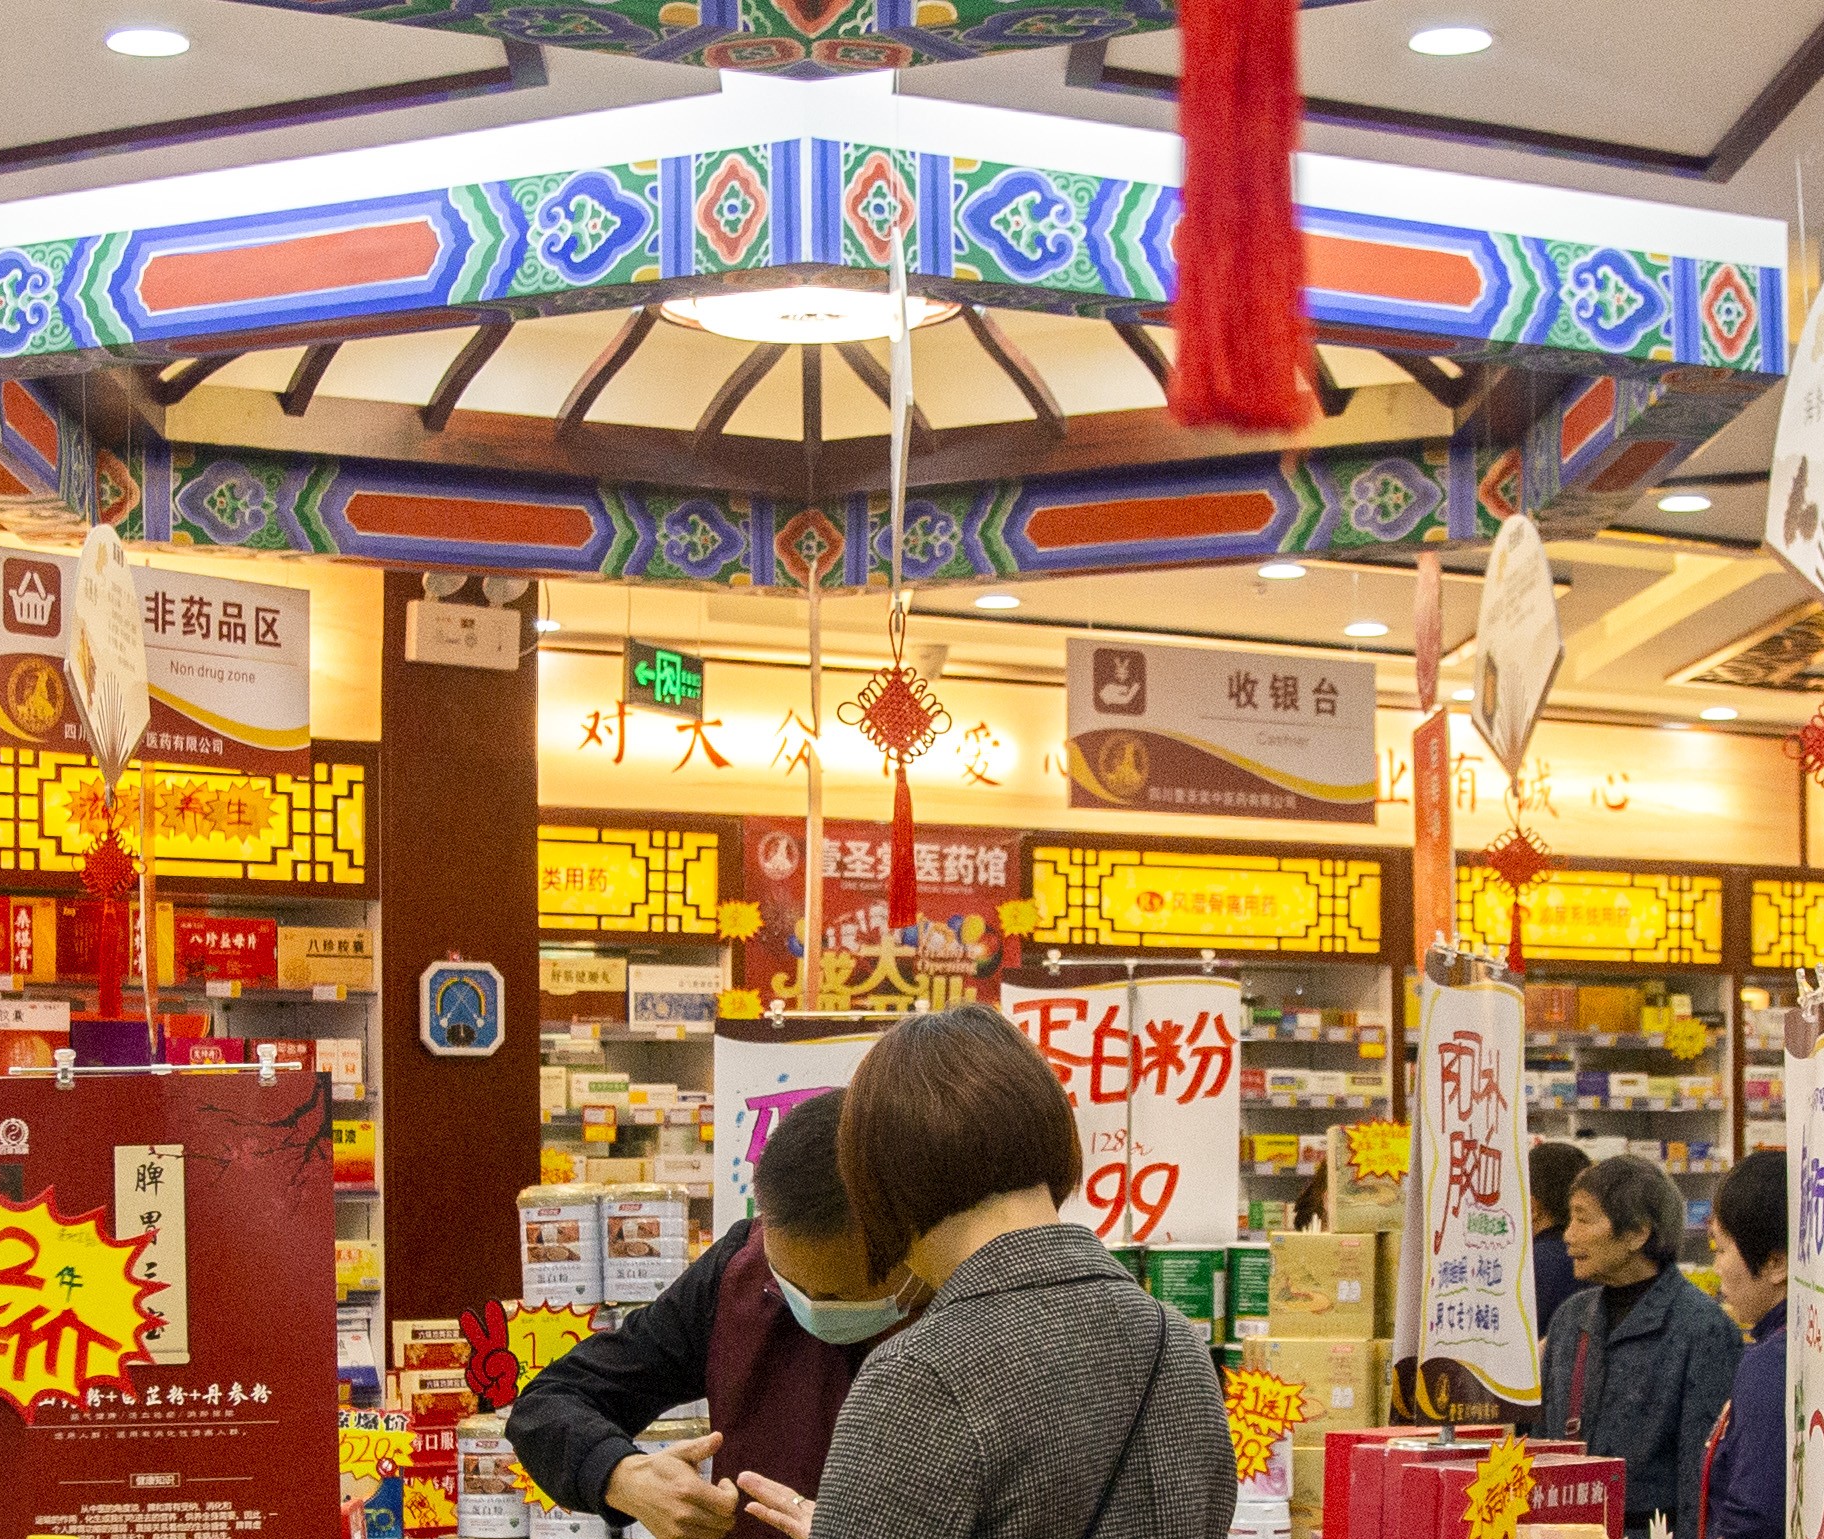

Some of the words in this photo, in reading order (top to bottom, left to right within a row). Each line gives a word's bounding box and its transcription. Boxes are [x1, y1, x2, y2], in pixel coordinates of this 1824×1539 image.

[144, 590, 282, 649] 非药品区
[169, 659, 195, 678] Non
[197, 663, 224, 683] drug
[225, 669, 256, 684] zone
[1227, 670, 1340, 717] 收银台
[146, 731, 224, 755] 医药有限公司
[1013, 997, 1238, 1109] 蛋白粉
